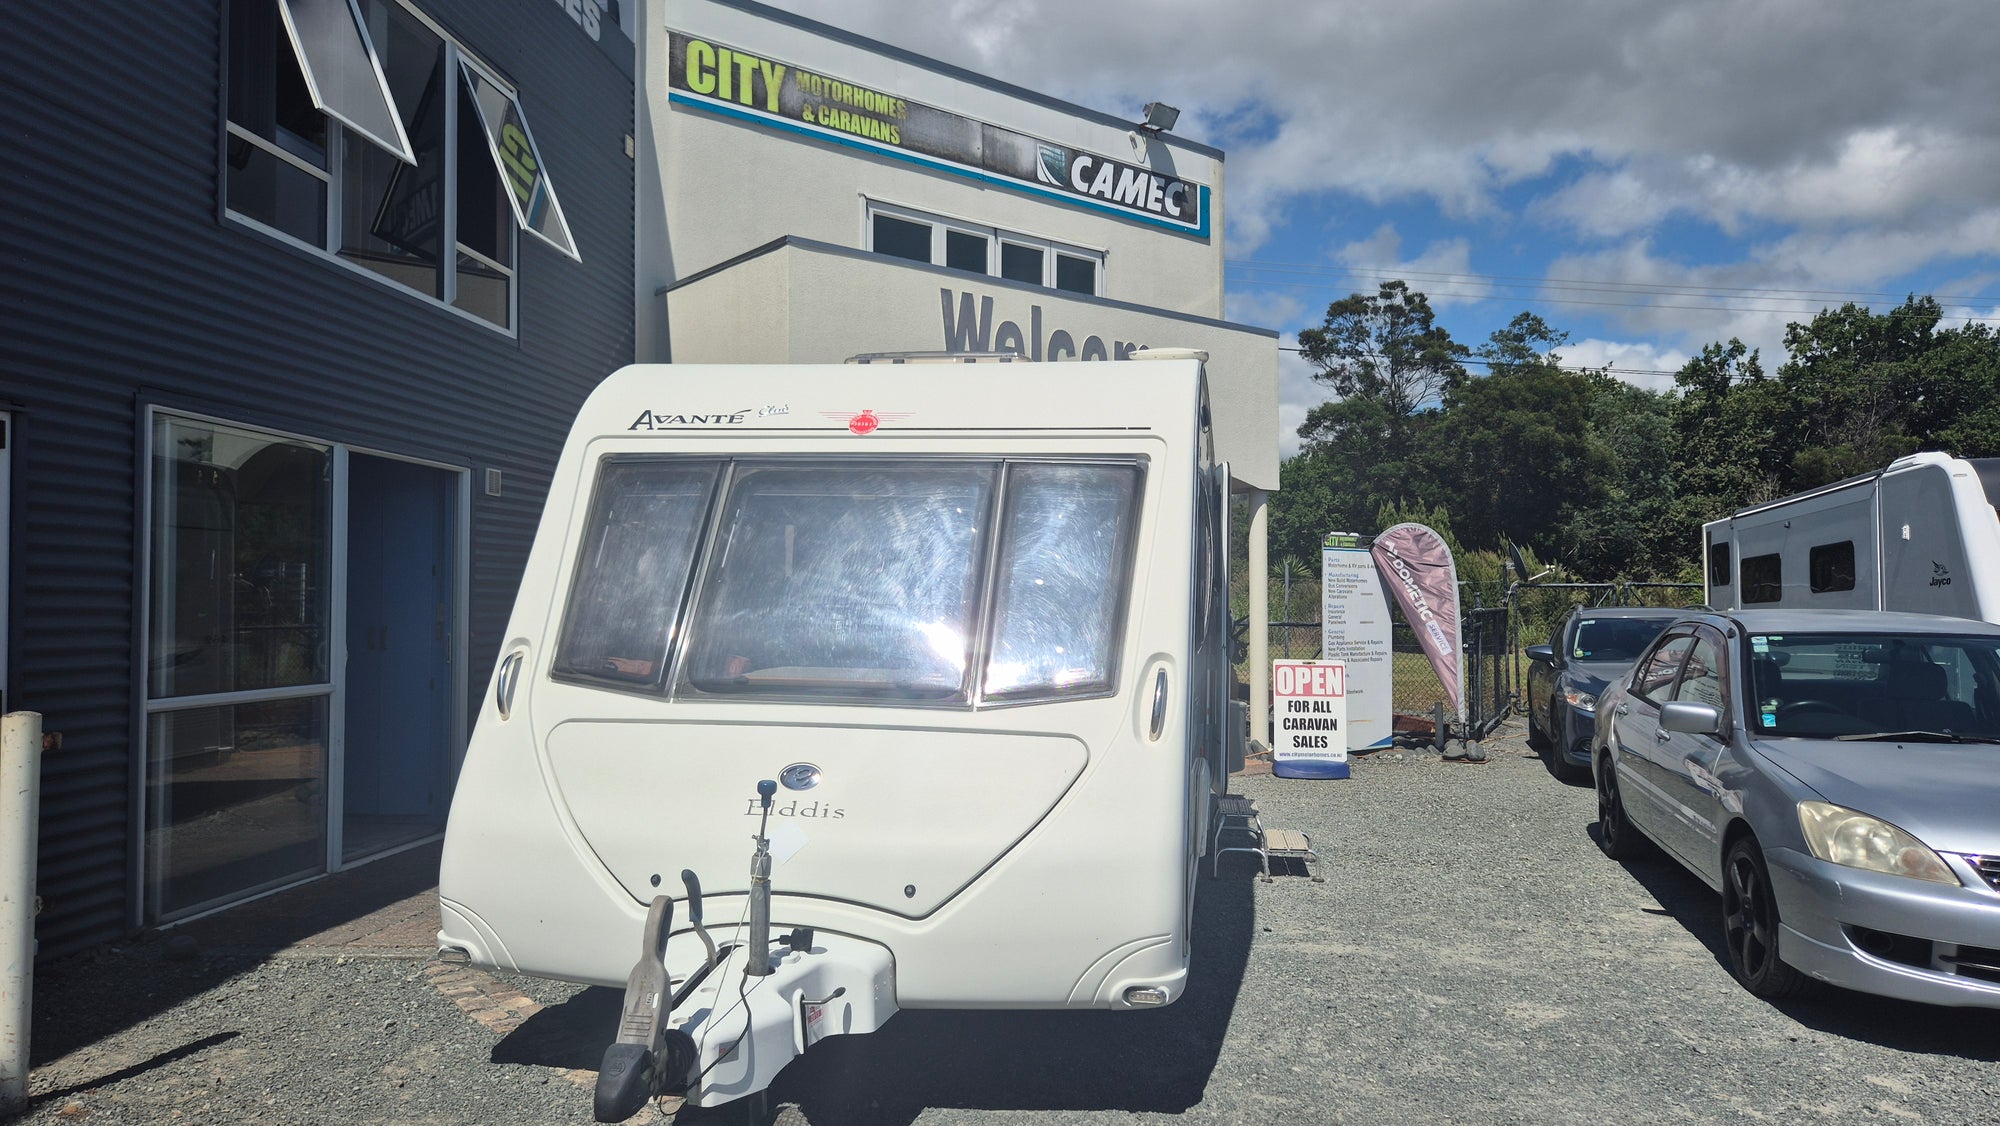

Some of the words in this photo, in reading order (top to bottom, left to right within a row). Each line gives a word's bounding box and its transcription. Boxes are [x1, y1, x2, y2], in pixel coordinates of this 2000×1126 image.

[686, 40, 786, 113] CITY
[795, 70, 907, 120] MOTORHOMES
[802, 103, 815, 123] &
[818, 105, 900, 145] CARAVANS
[1071, 155, 1184, 217] CAMEC
[1392, 559, 1433, 621] DOMETIC
[1929, 577, 1951, 588] Jayco
[1429, 623, 1449, 653] SERVICE
[1276, 666, 1343, 695] OPEN
[1287, 700, 1310, 713] FOR
[1312, 701, 1332, 713] ALL
[1283, 717, 1338, 731] CARAVAN
[1292, 735, 1328, 748] SALES
[744, 798, 845, 819] Elddis
